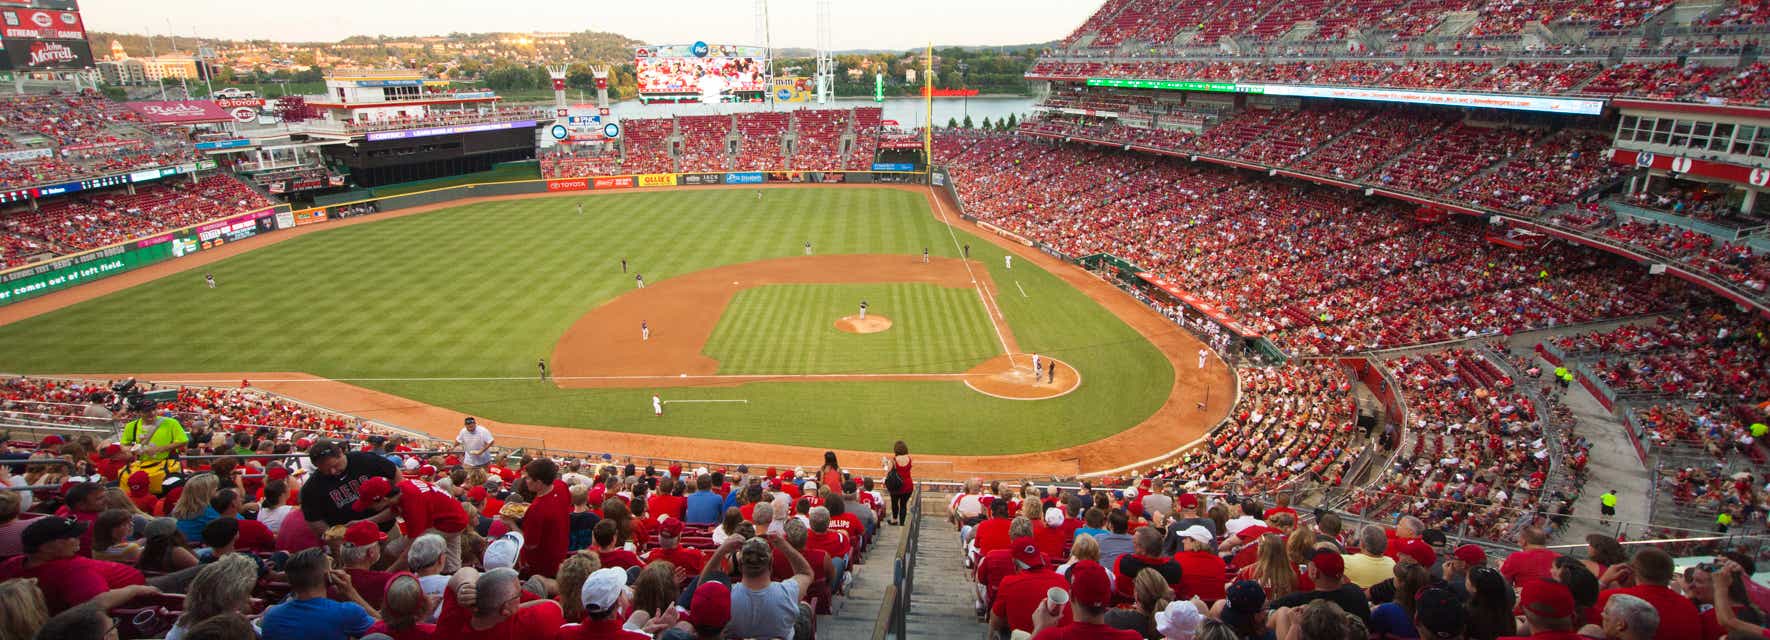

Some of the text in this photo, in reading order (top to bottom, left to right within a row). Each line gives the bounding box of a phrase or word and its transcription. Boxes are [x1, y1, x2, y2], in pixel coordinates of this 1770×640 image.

[58, 30, 81, 39] GAMES
[44, 42, 62, 52] John
[29, 47, 78, 66] Morrell
[143, 103, 205, 116] Reds
[561, 181, 586, 189] TOYOTA
[14, 281, 46, 296] comes
[49, 275, 66, 286] out
[68, 271, 79, 281] of
[81, 266, 99, 277] left
[101, 260, 125, 272] field.
